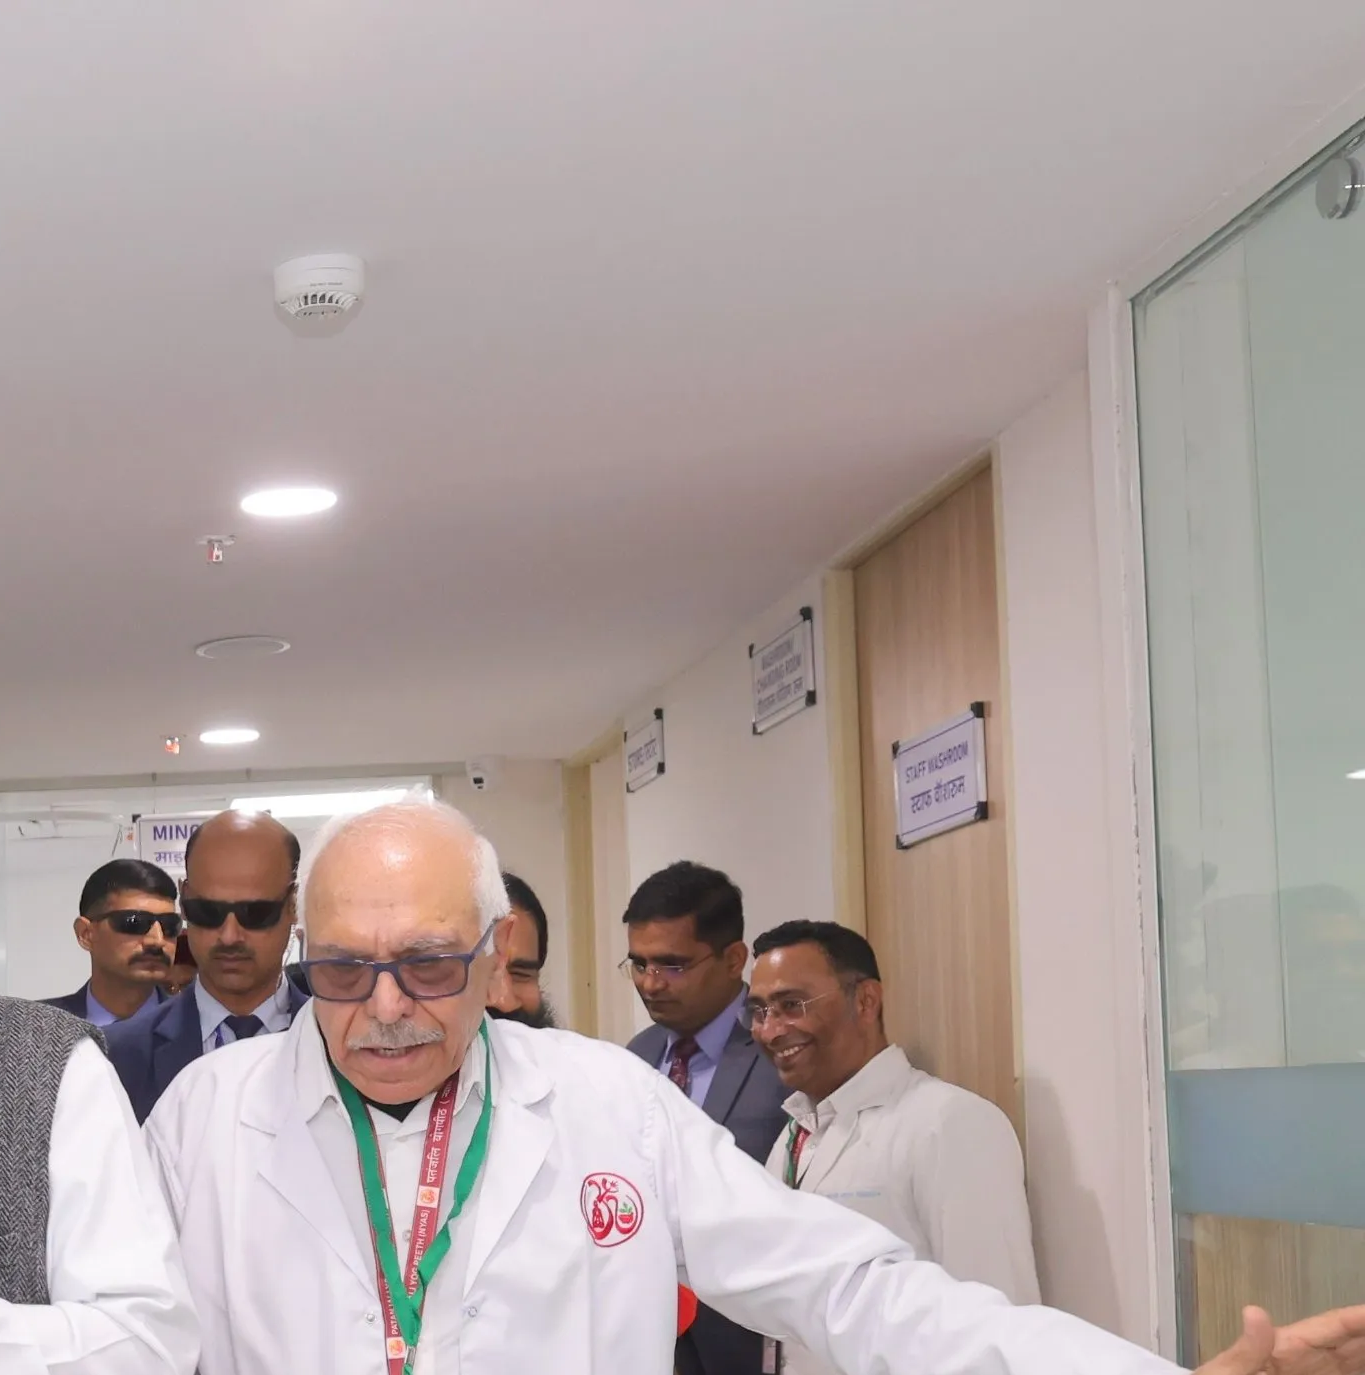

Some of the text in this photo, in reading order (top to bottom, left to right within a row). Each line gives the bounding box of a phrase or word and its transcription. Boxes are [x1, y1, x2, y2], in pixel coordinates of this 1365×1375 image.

[905, 740, 969, 784] STAFF WASHROOM
[417, 1209, 431, 1238] (NYAS)
[412, 1238, 425, 1266] PEETH
